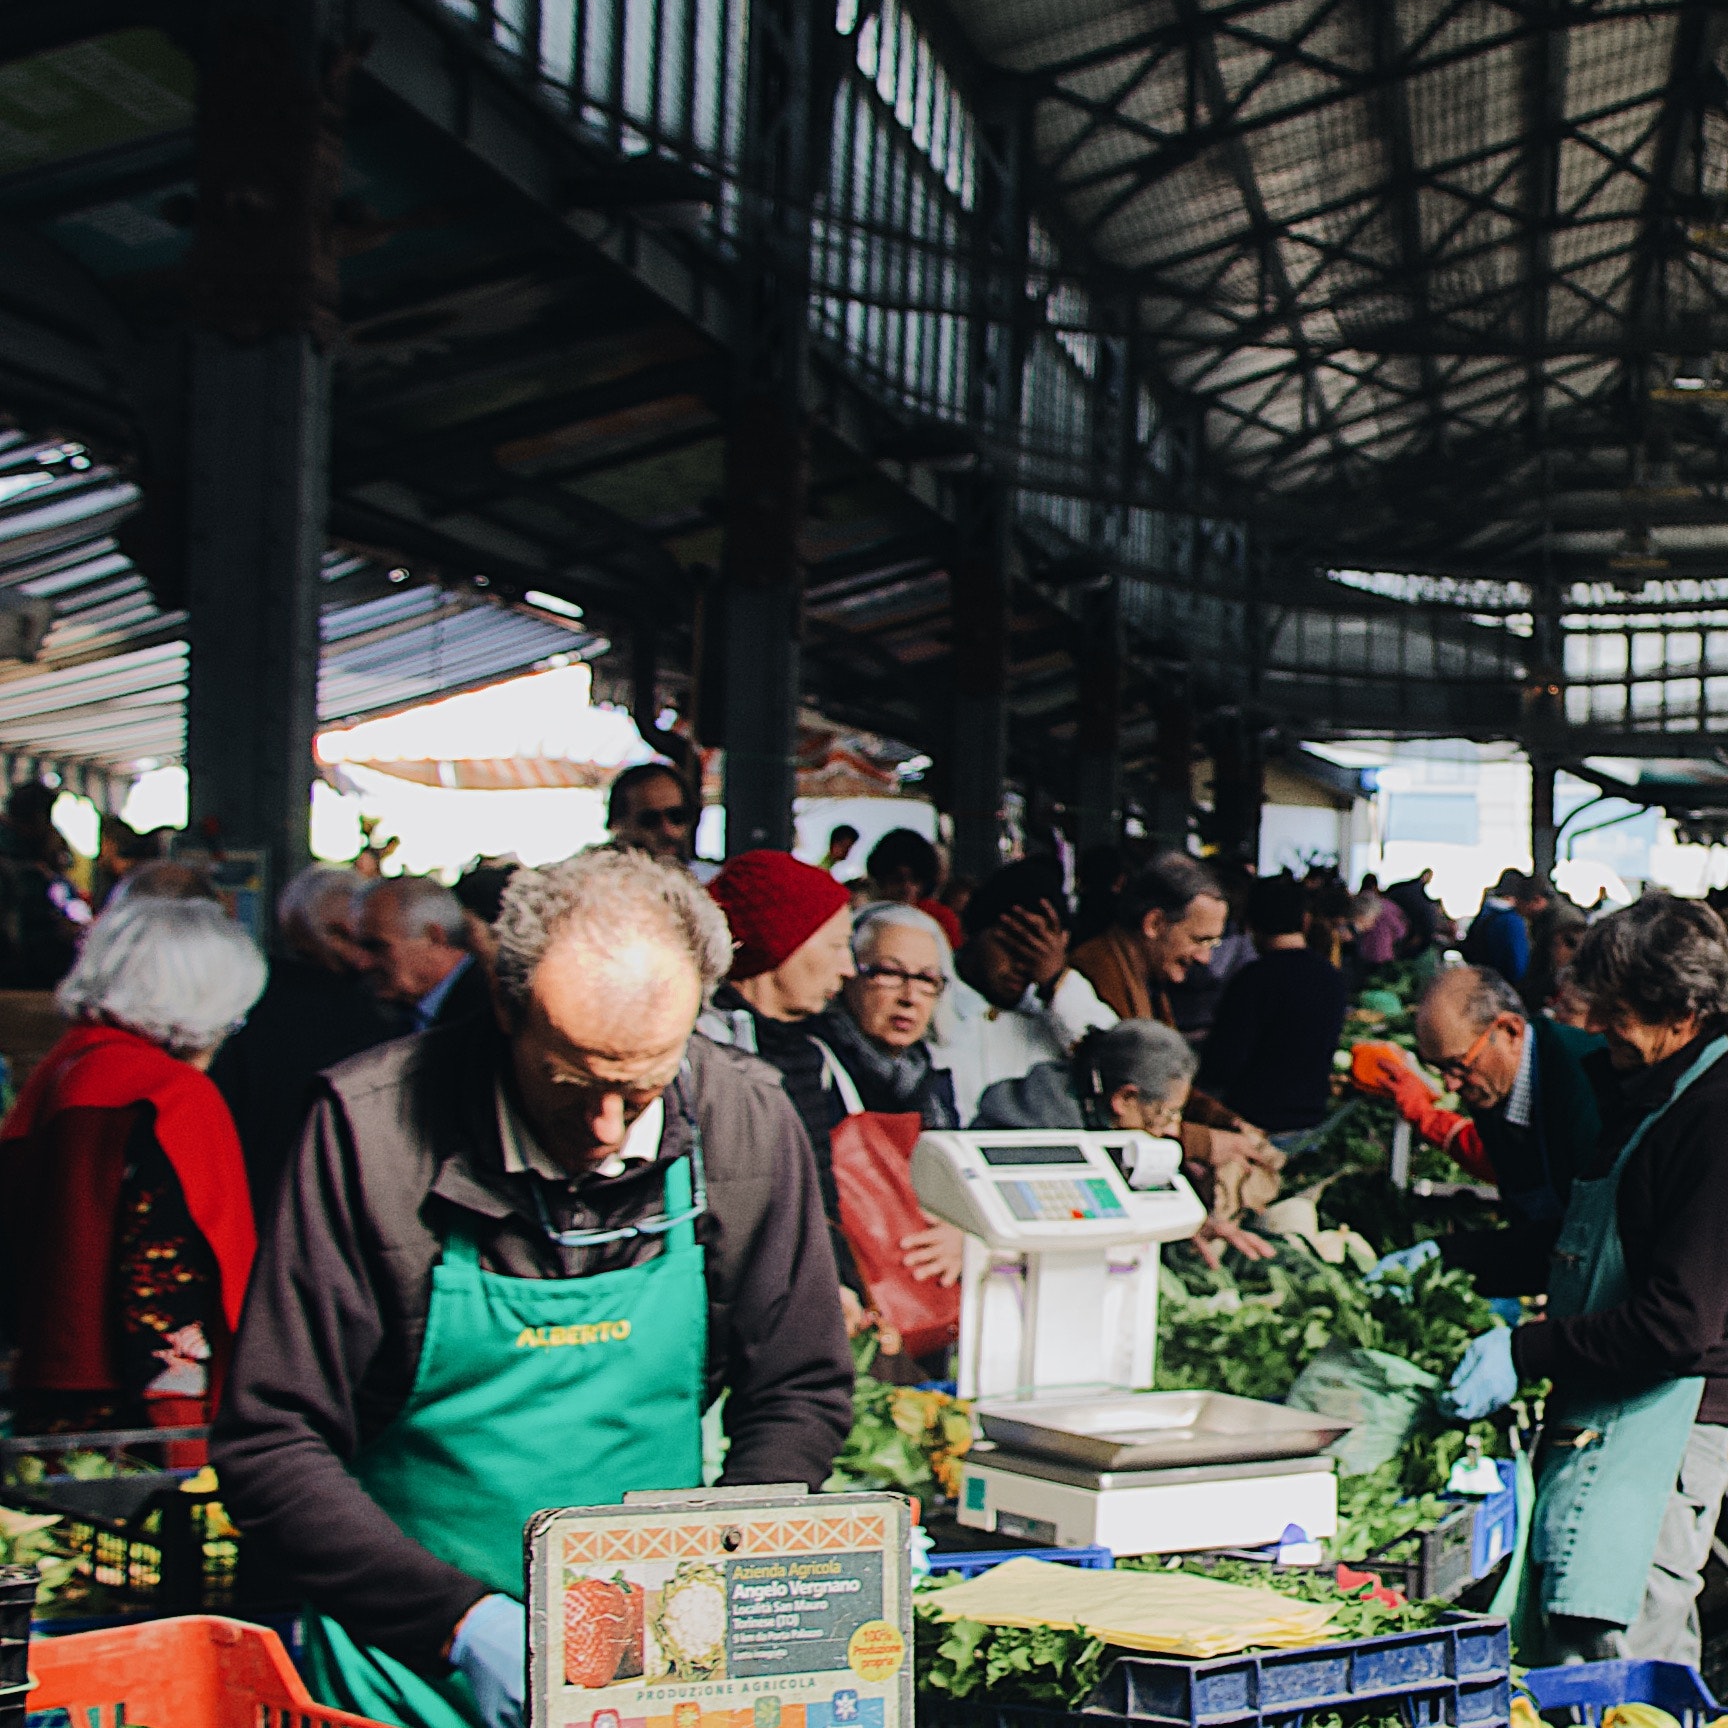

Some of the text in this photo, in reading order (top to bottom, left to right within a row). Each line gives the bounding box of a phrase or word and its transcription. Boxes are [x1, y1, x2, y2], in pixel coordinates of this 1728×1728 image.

[516, 1320, 631, 1347] ALBERTO
[732, 1561, 842, 1580] Azienda Agricola
[732, 1578, 862, 1602] Angelo Vergnano
[732, 1599, 829, 1616] Località San Mauro
[732, 1616, 775, 1630] Torinese
[863, 1629, 893, 1642] 100%
[853, 1643, 901, 1656] Produzione
[861, 1657, 894, 1671] propria
[636, 1676, 816, 1702] PRODUZIONE AGRICOLA
